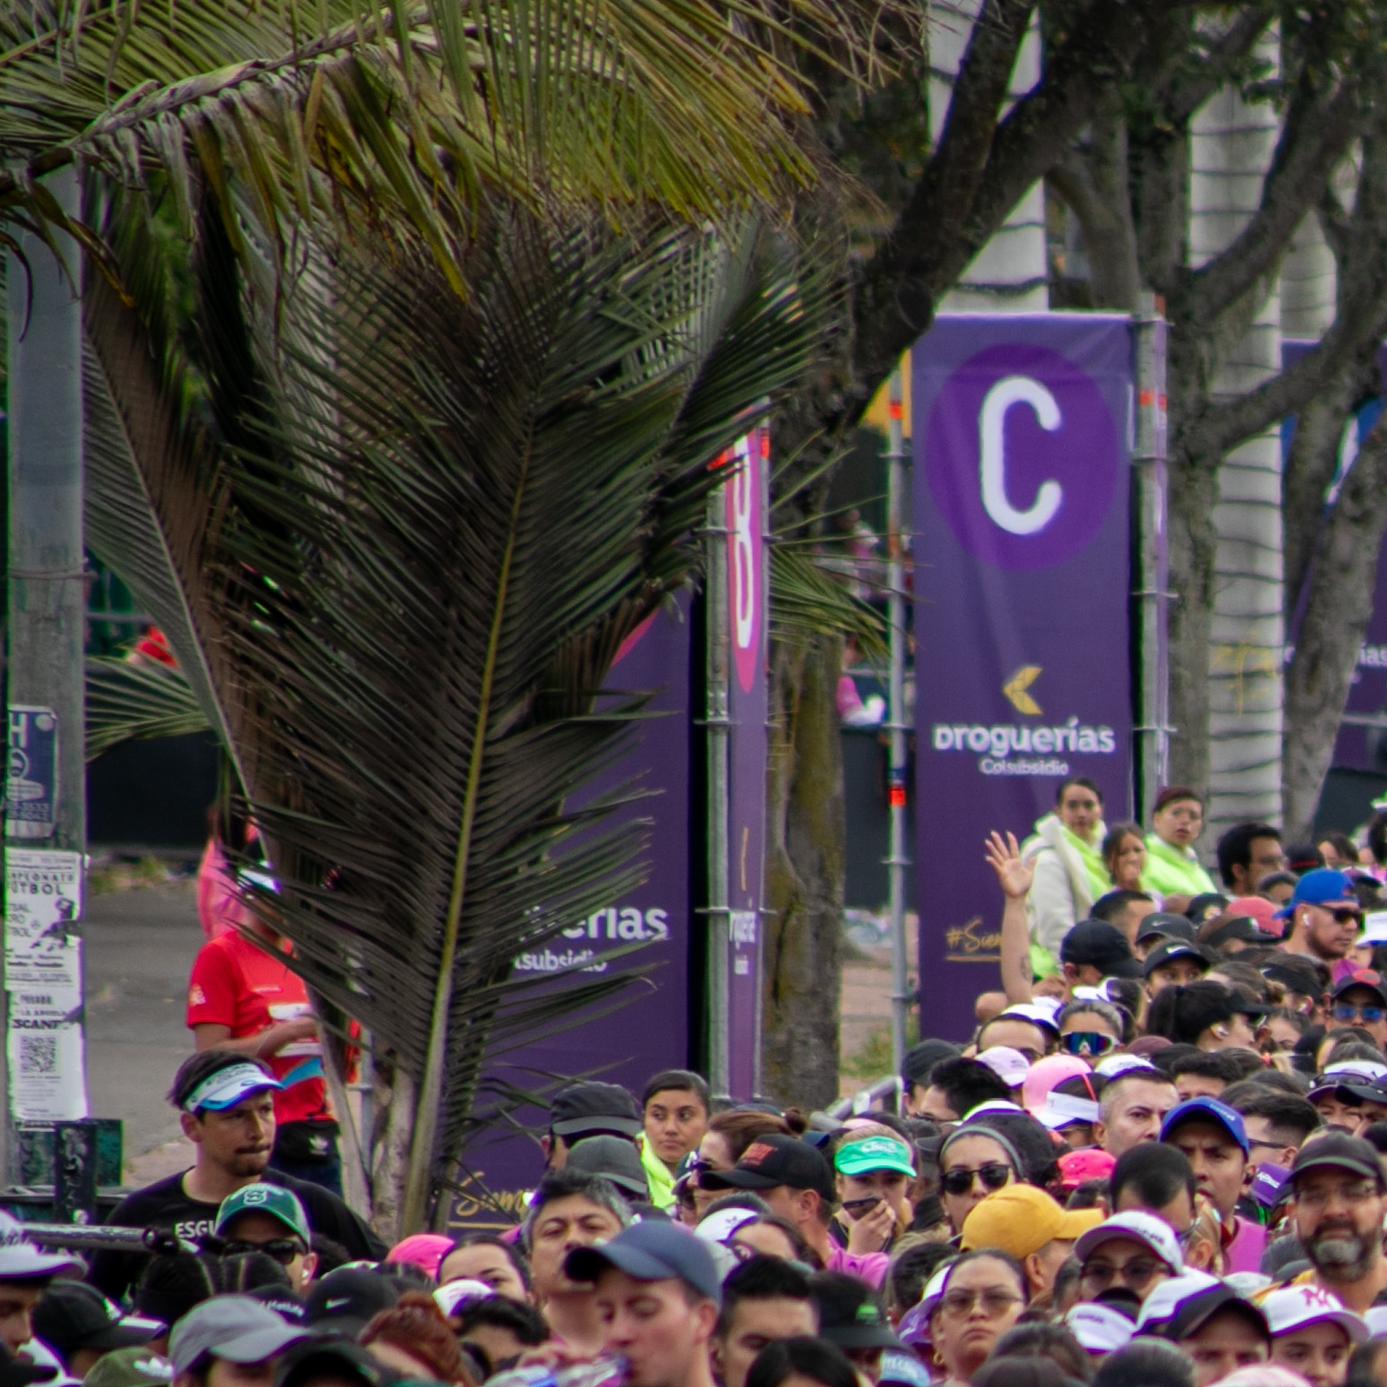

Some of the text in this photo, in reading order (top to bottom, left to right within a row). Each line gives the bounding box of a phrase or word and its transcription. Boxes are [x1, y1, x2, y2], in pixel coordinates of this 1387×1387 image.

[980, 375, 1062, 535] C
[933, 716, 1116, 757] Droguerías
[979, 758, 1069, 775] Colsubsidio
